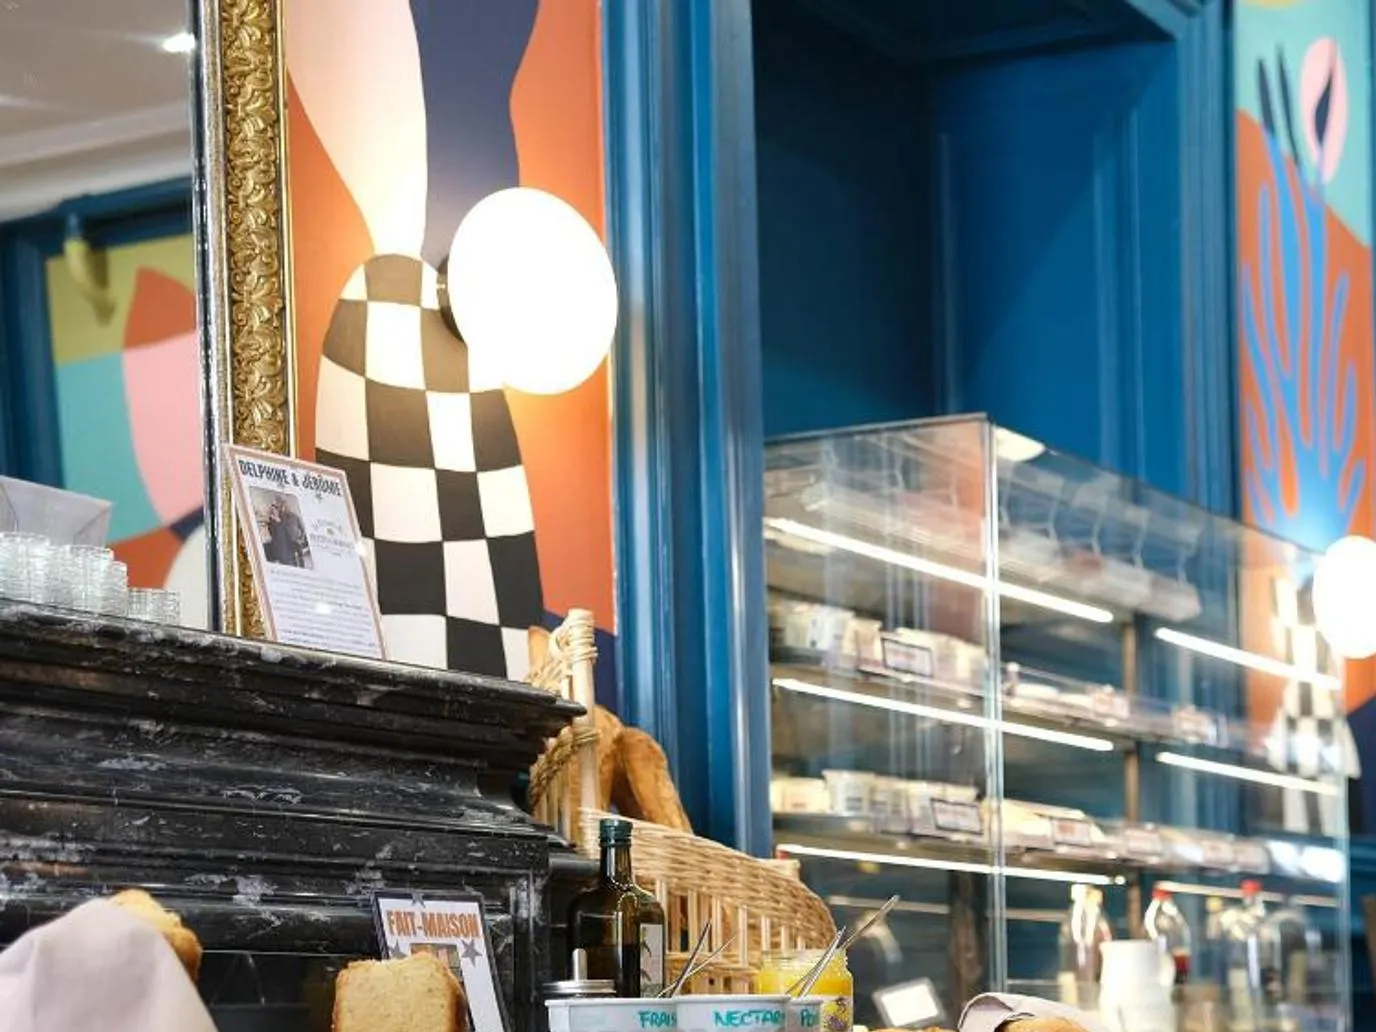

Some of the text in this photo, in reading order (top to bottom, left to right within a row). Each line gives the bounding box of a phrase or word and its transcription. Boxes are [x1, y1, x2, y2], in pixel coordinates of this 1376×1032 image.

[238, 459, 290, 485] DELPHINE
[291, 472, 300, 487] &
[387, 910, 480, 938] FAIT-MAISON
